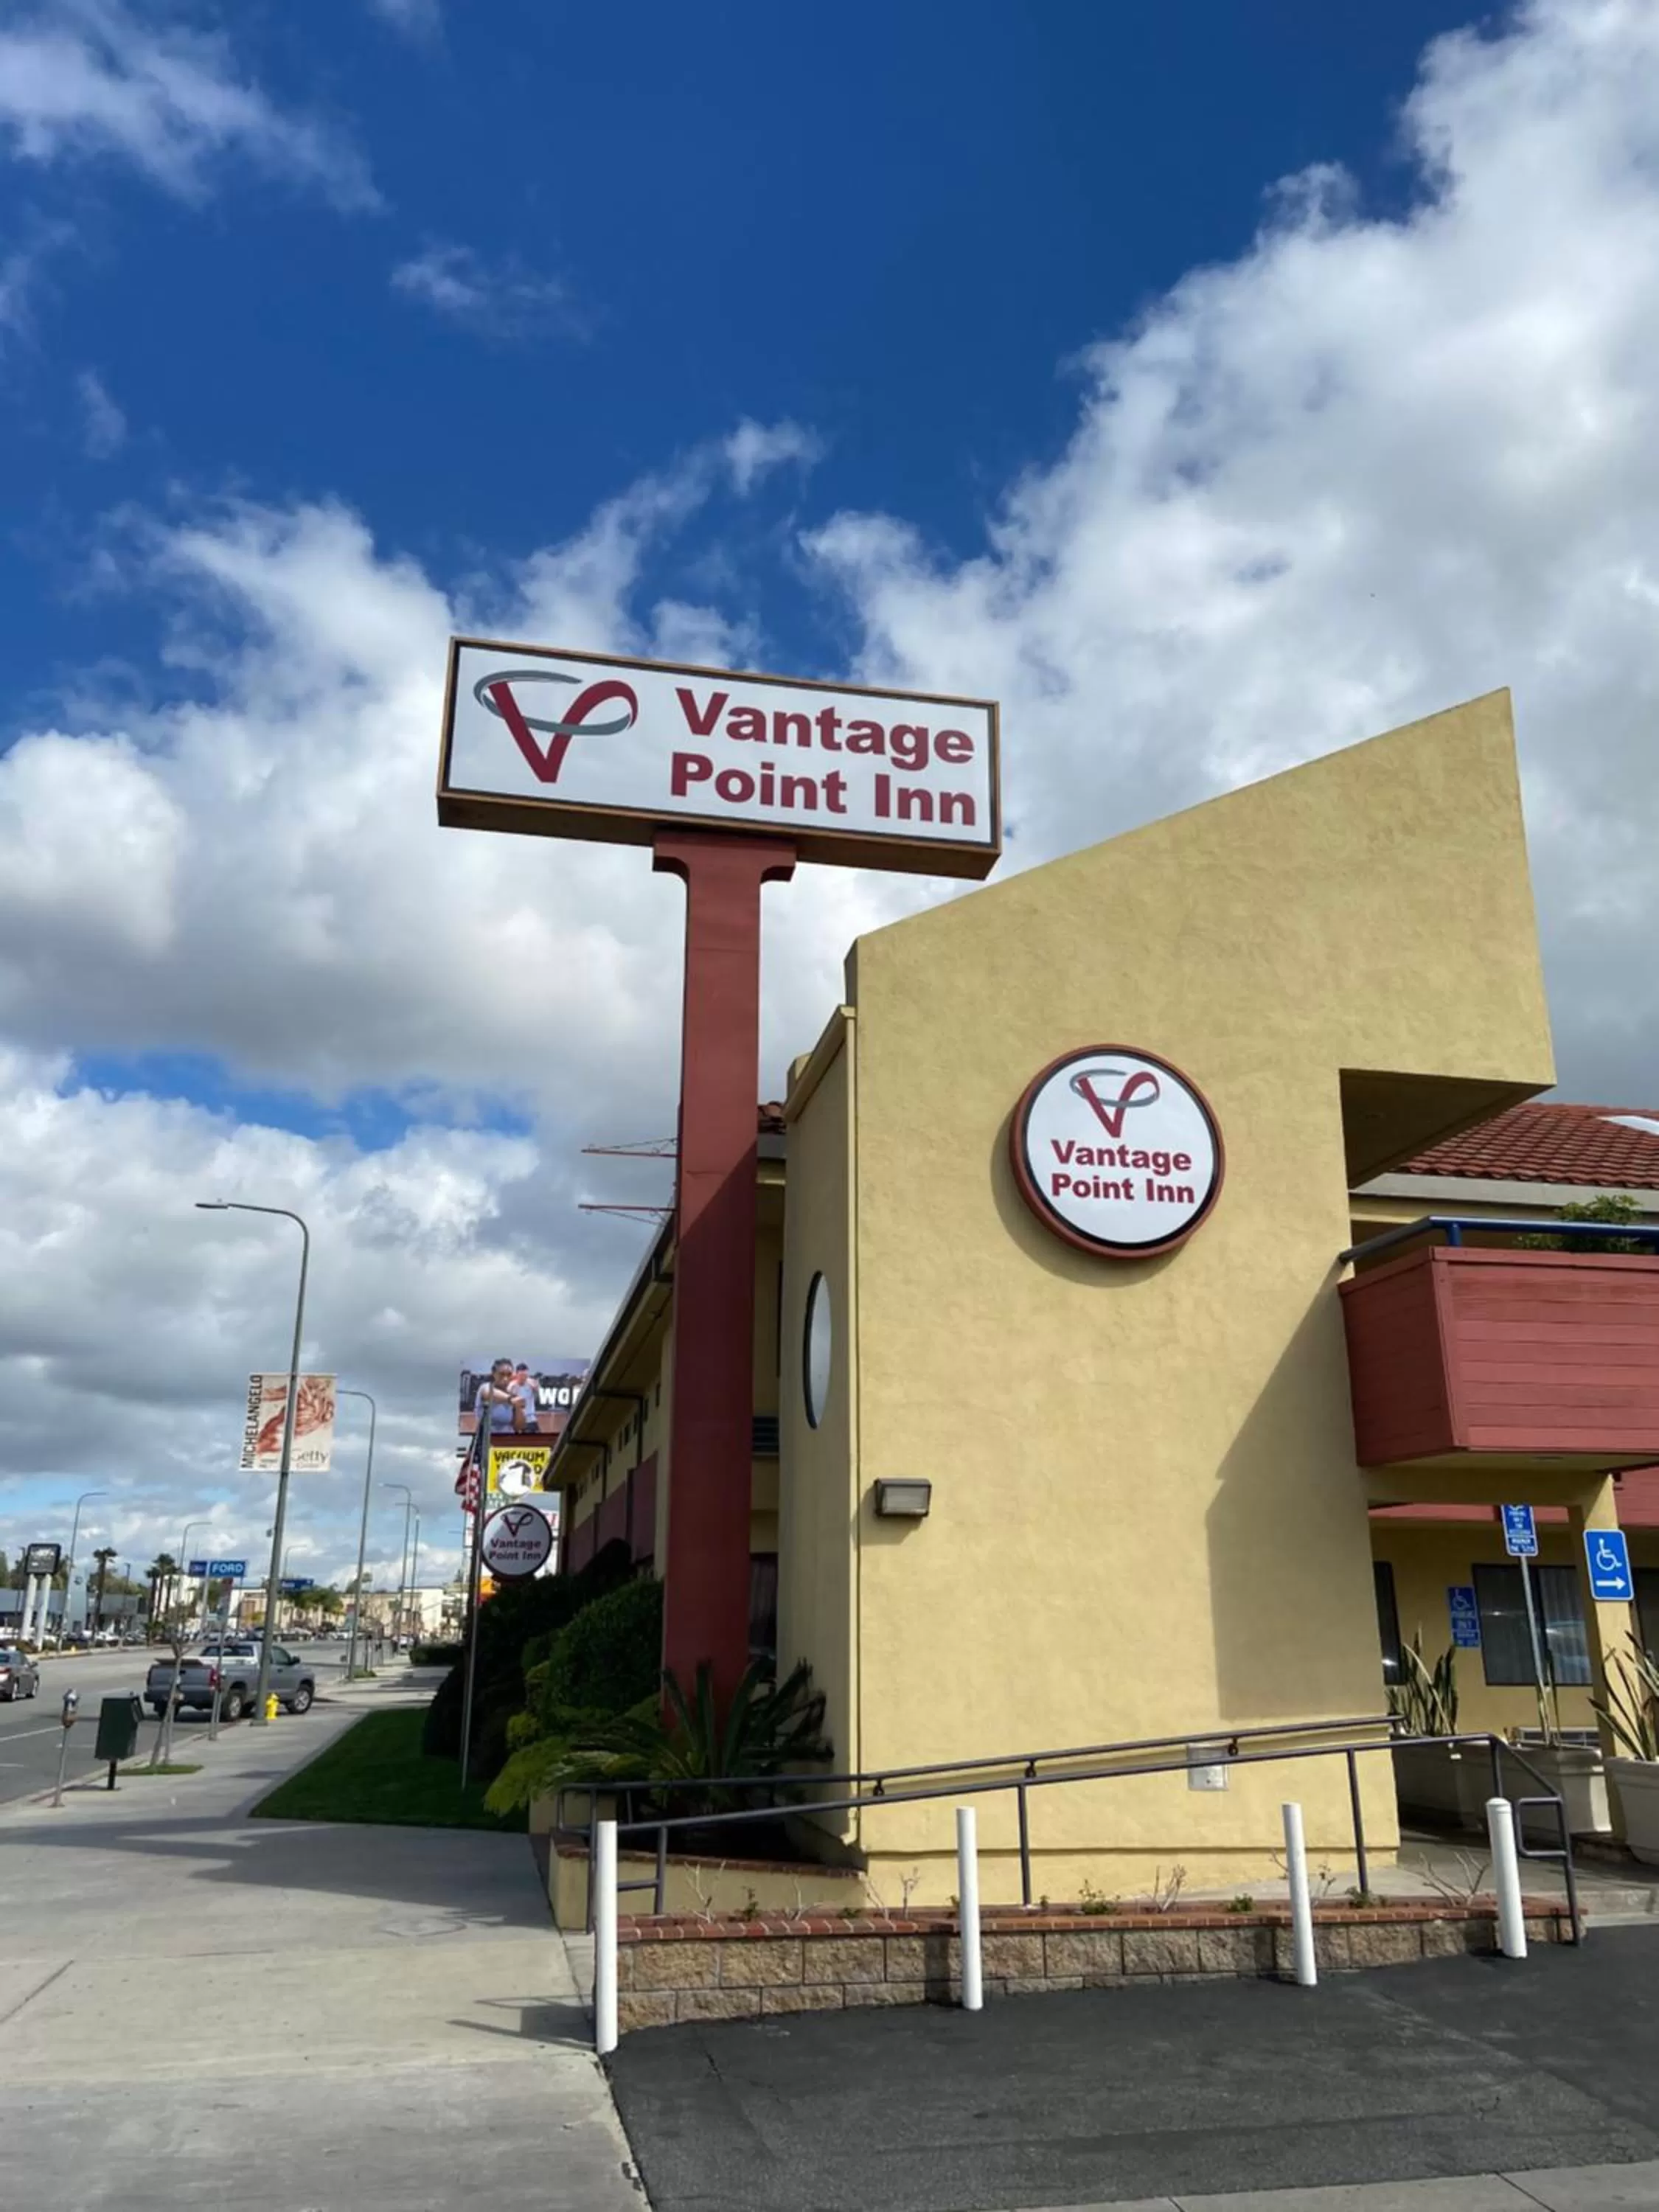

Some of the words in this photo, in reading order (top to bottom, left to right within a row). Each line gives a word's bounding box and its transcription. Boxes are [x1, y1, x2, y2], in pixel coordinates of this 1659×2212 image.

[675, 687, 975, 771] Vantage
[670, 752, 848, 813] Point
[874, 773, 975, 826] Inn
[1051, 1139, 1192, 1176] Vantage
[1051, 1173, 1134, 1200] Point
[1147, 1178, 1194, 1203] Inn
[241, 1374, 262, 1469] MICHELANGELO
[489, 1551, 518, 1560] Point
[523, 1551, 540, 1560] Inn
[490, 1538, 541, 1550] Vantage
[212, 1562, 243, 1573] FORD
